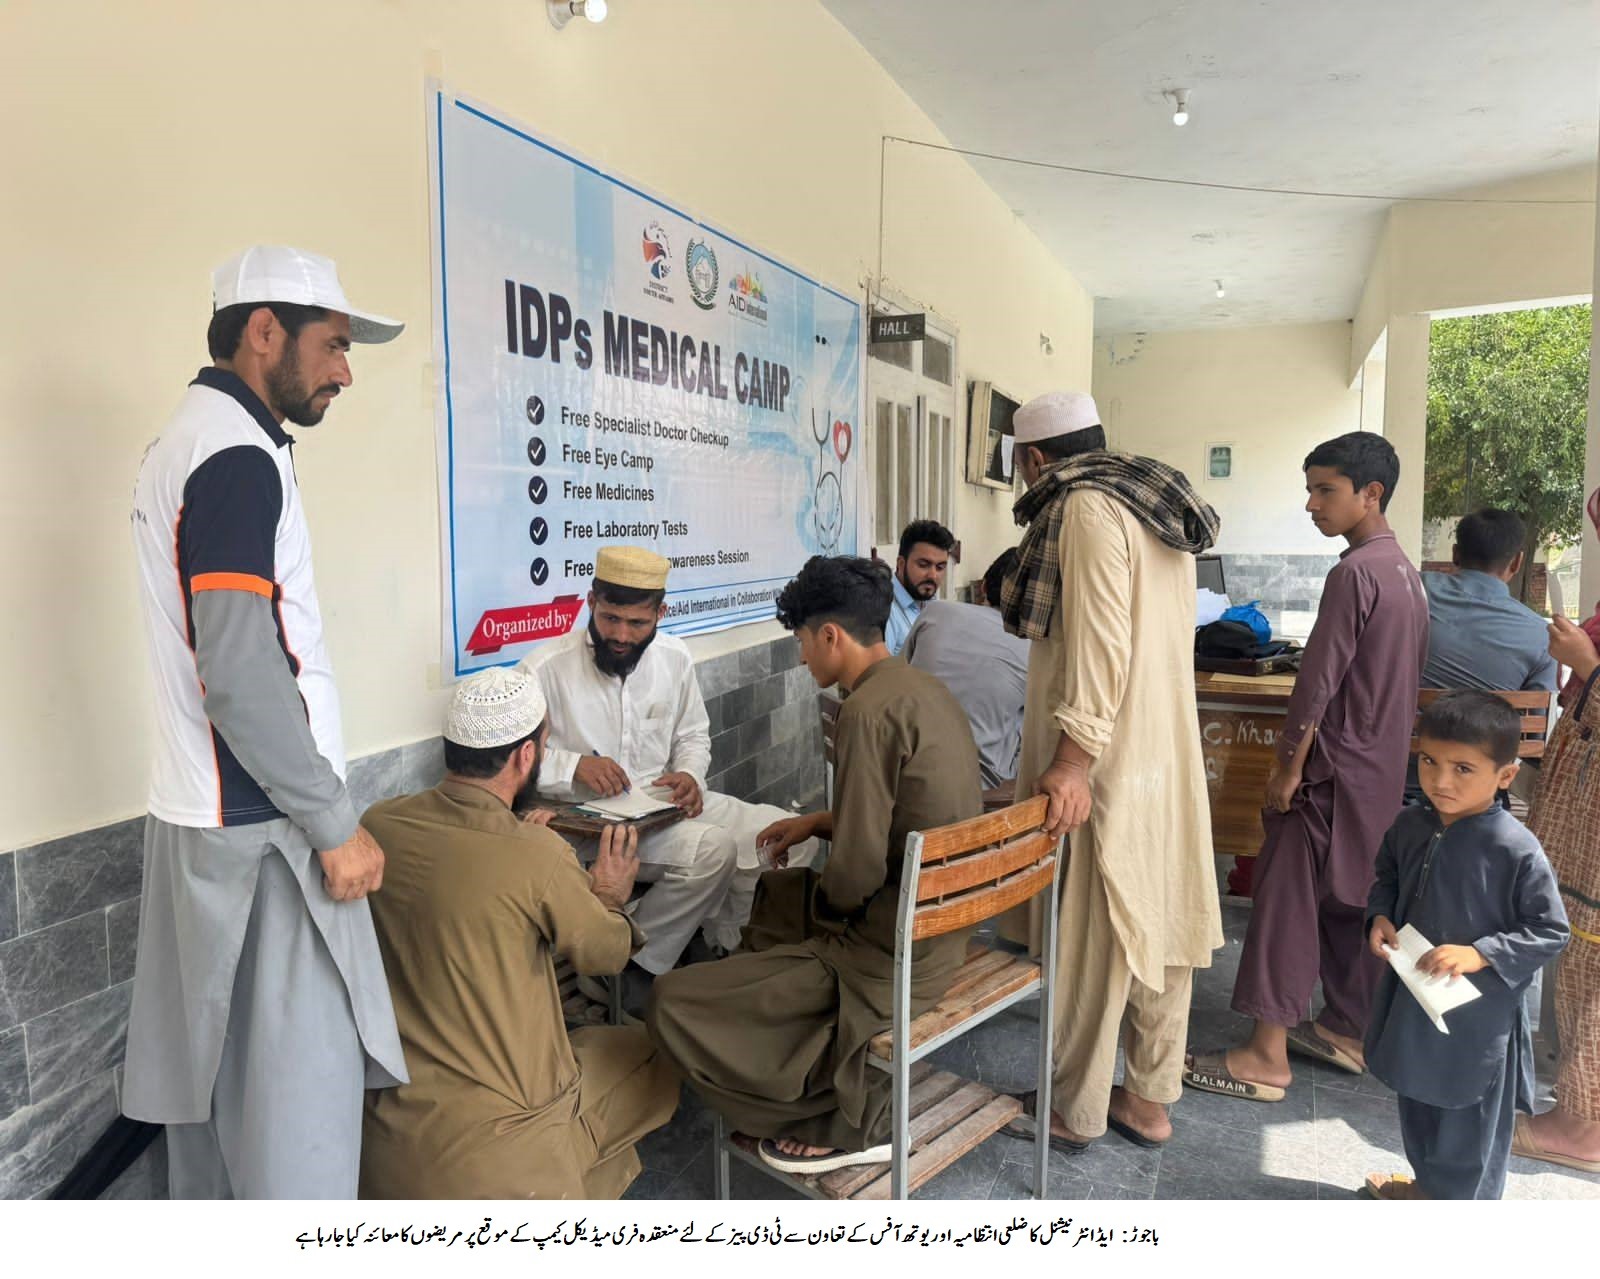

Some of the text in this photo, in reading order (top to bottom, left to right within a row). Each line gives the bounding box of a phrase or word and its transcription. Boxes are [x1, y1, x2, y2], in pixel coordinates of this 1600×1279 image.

[728, 293, 746, 312] AID
[879, 321, 910, 336] HALL
[505, 279, 790, 412] IDPs MEDICAL CAMP
[561, 406, 729, 449] Free Specialist Doctor Checkup
[562, 444, 654, 472] Free Eye Camp
[563, 480, 655, 501] Free Medicines
[564, 519, 688, 540] Free Laboratory Tests
[564, 559, 594, 577] Free
[717, 549, 750, 565] Session
[690, 592, 729, 615] International
[730, 593, 737, 607] in
[482, 608, 573, 641] Organized by:
[1192, 1073, 1247, 1093] BALMAIN
